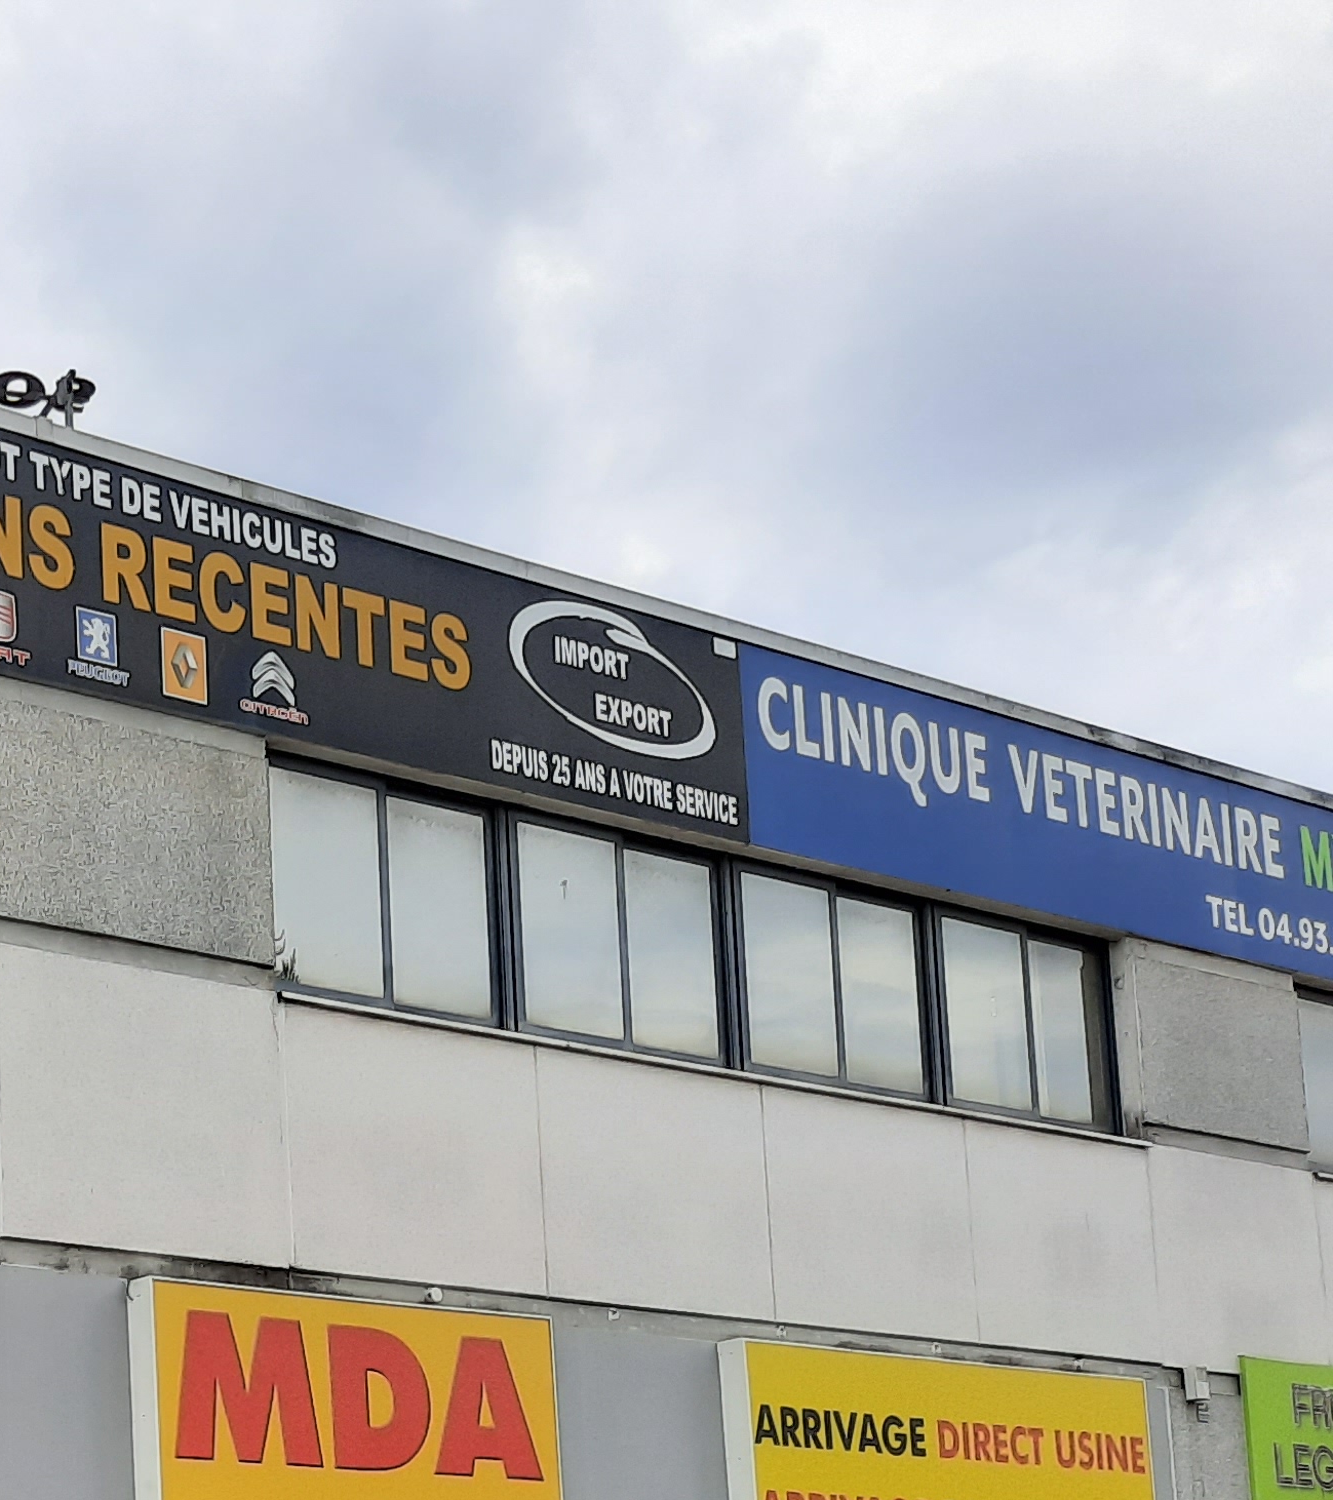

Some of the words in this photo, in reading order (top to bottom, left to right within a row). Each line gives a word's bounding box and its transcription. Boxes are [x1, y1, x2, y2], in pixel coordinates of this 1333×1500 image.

[30, 452, 114, 511] TYPE
[120, 476, 164, 521] DE
[170, 493, 338, 569] VEHICULES
[100, 520, 472, 692] RECENTES
[67, 658, 131, 687] PEUGEOT
[554, 635, 630, 680] IMPORT
[594, 693, 672, 737] EXPORT
[491, 738, 548, 782] DEPUIS
[552, 753, 571, 786] 25
[575, 759, 606, 795] ANS
[609, 768, 621, 798] A
[624, 770, 673, 810] VOTRE
[676, 783, 738, 826] SERVICE
[757, 676, 991, 808] CLINIQUE
[1007, 743, 1285, 880] VETERINAIRE
[1205, 894, 1255, 937] TEL
[174, 1308, 544, 1482] MDA
[754, 1403, 927, 1457] ARRIVAGE
[937, 1418, 1043, 1465] DIRECT
[1054, 1428, 1146, 1475] USINE
